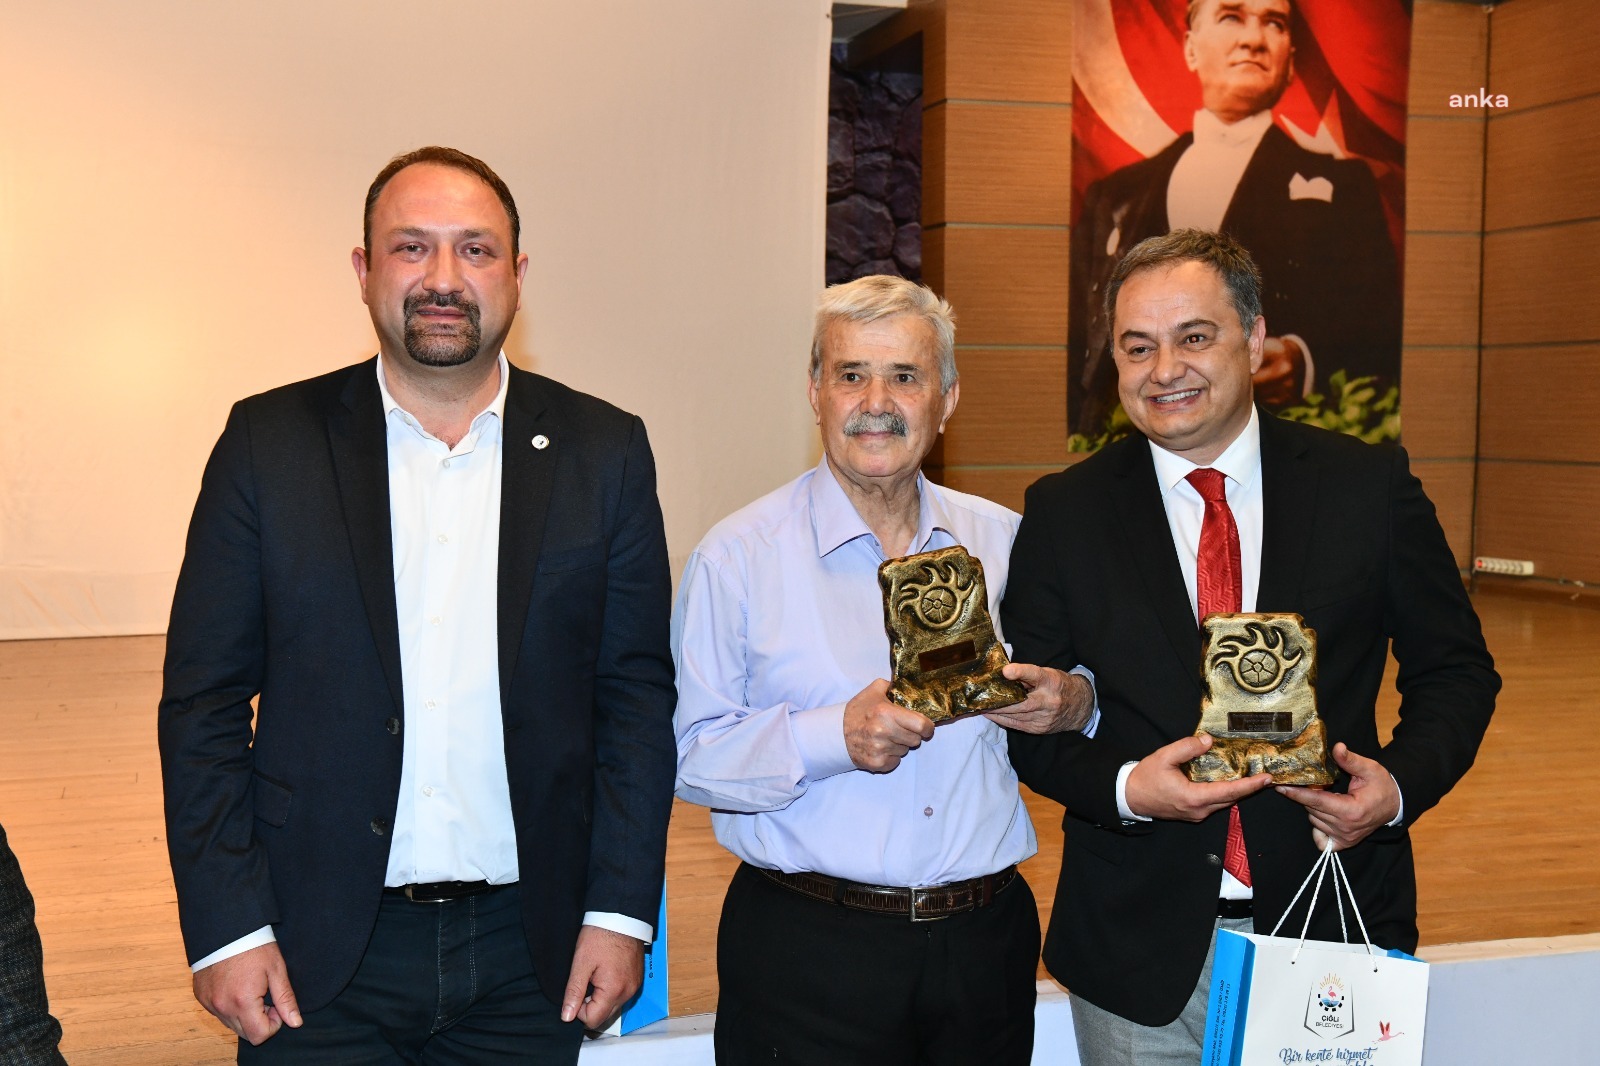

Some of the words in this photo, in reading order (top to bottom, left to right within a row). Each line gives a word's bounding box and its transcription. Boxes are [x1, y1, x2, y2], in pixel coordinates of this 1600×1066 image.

[1279, 1047, 1303, 1066] Bir
[1305, 1048, 1333, 1062] kente
[1336, 1047, 1378, 1065] hizmet
